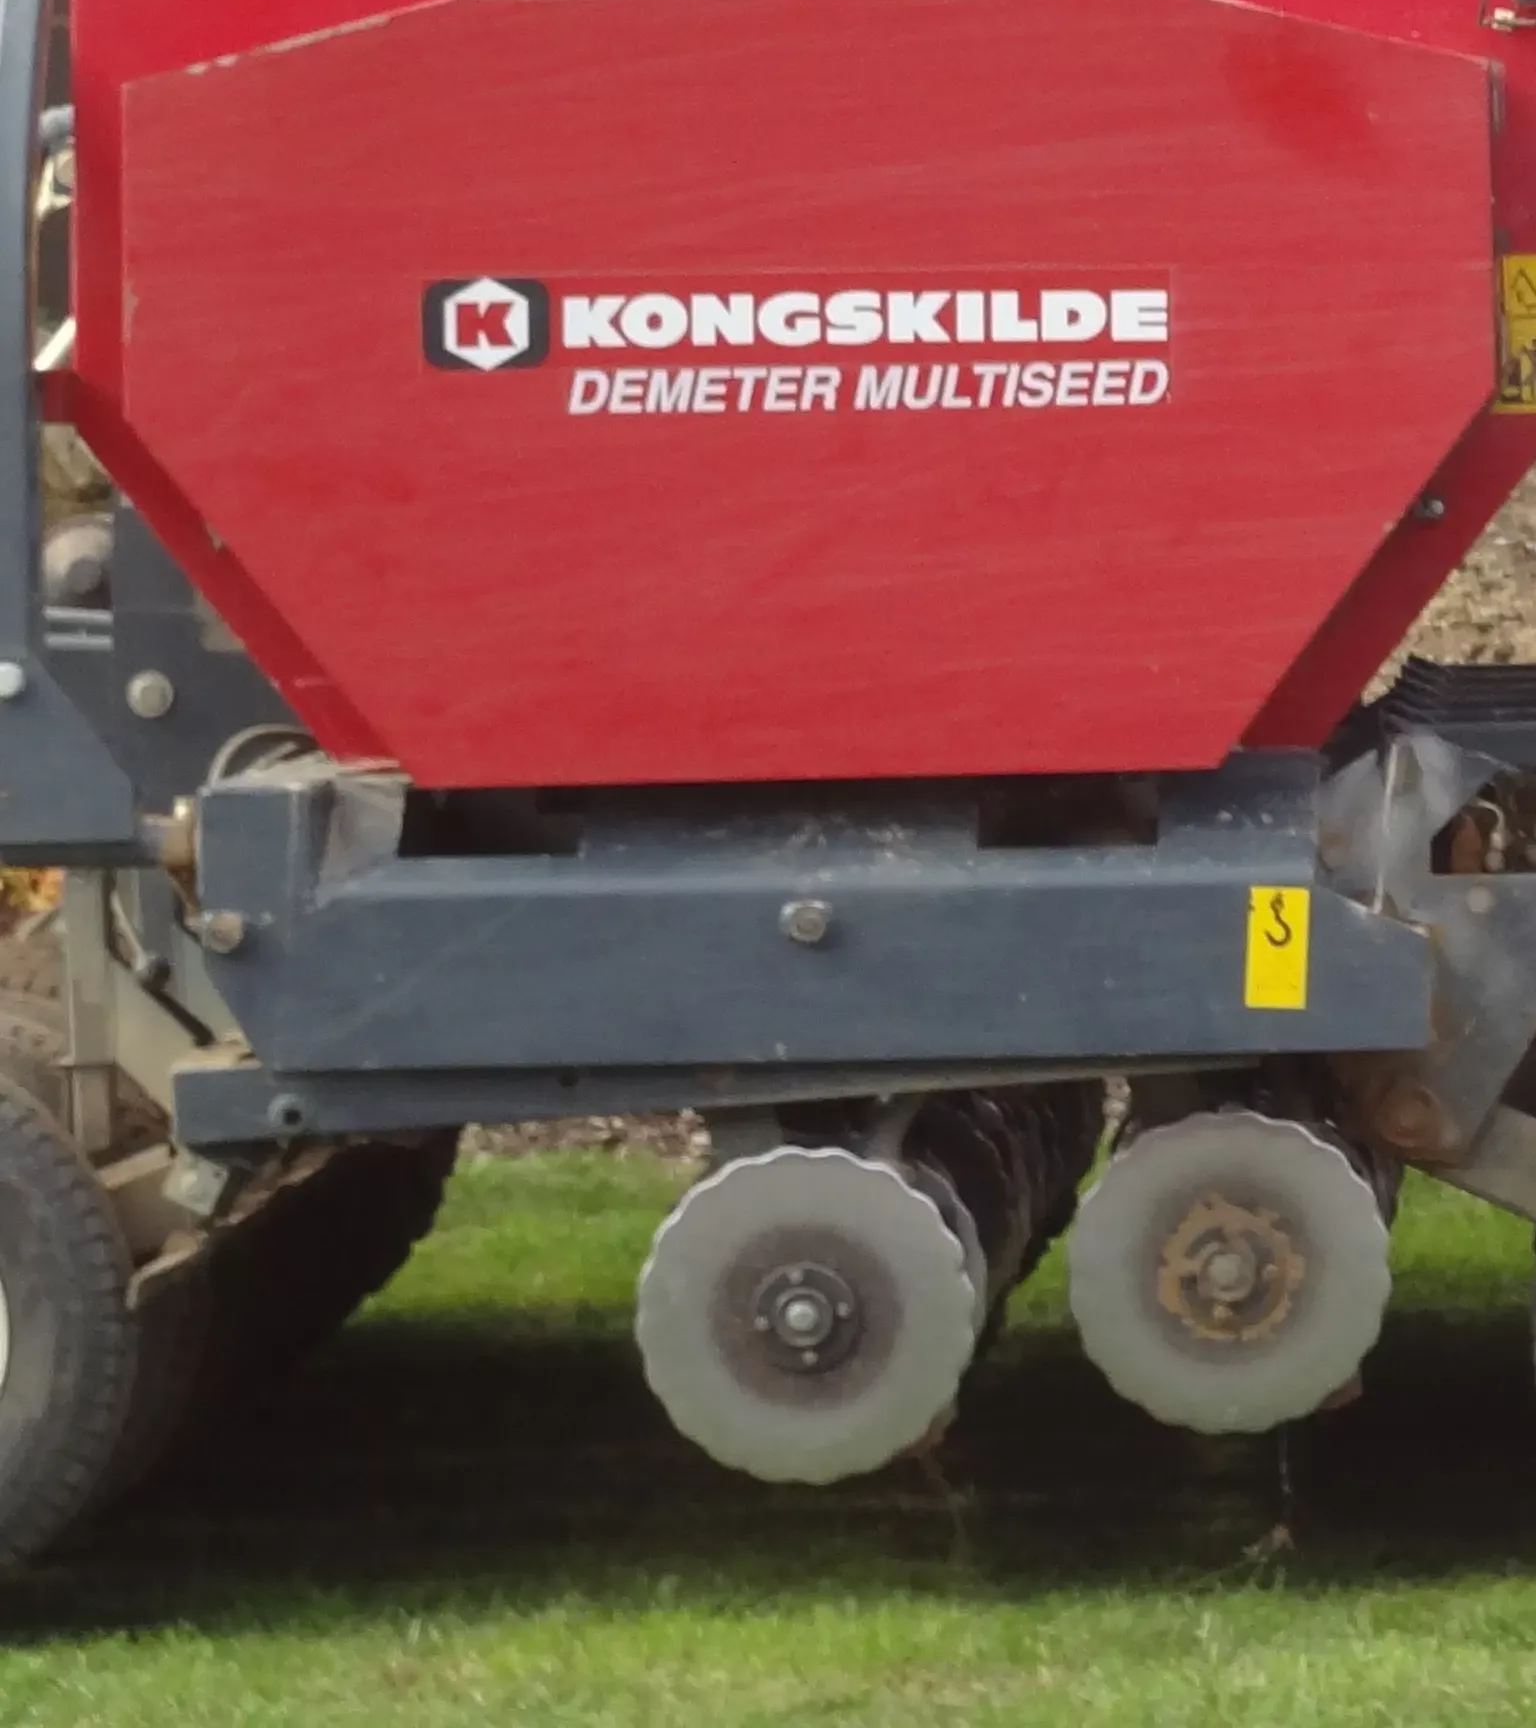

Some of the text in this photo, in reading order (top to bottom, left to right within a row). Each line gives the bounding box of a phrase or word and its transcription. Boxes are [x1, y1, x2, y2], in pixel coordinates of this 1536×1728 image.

[561, 288, 1169, 349] KONGSKILDE
[566, 359, 1170, 416] DEMETER MULTISEED
